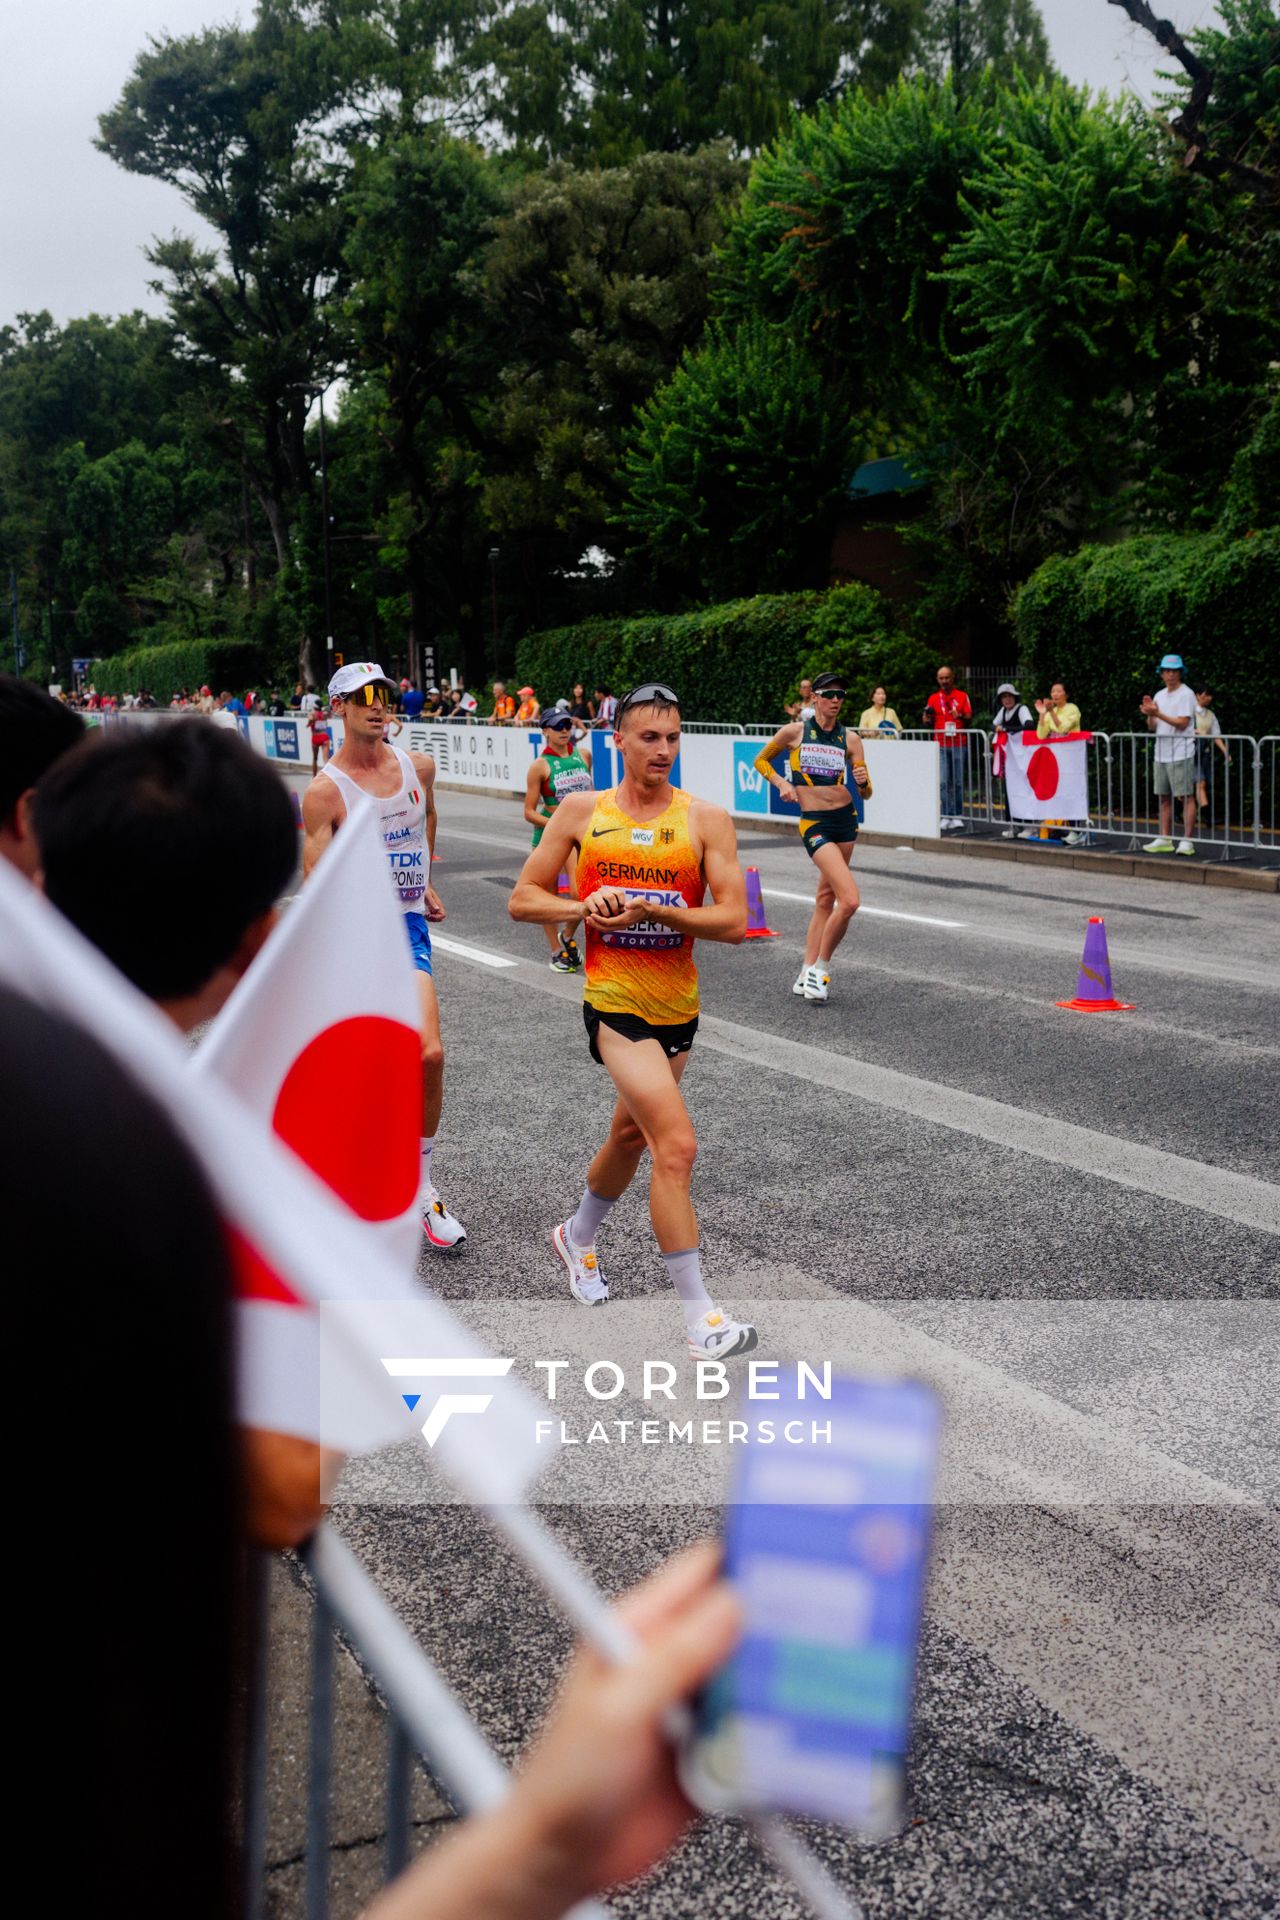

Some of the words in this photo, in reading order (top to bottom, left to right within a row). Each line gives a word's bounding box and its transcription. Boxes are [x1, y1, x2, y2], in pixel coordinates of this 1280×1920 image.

[453, 735, 508, 757] MORI
[803, 746, 843, 757] HONDA
[454, 760, 510, 780] BUILDING
[554, 767, 586, 781] PORTUGAL
[556, 775, 588, 787] HONDA
[383, 827, 410, 842] TALIA
[632, 832, 653, 842] WGV
[386, 851, 423, 868] TDK
[596, 861, 679, 884] GERMANY
